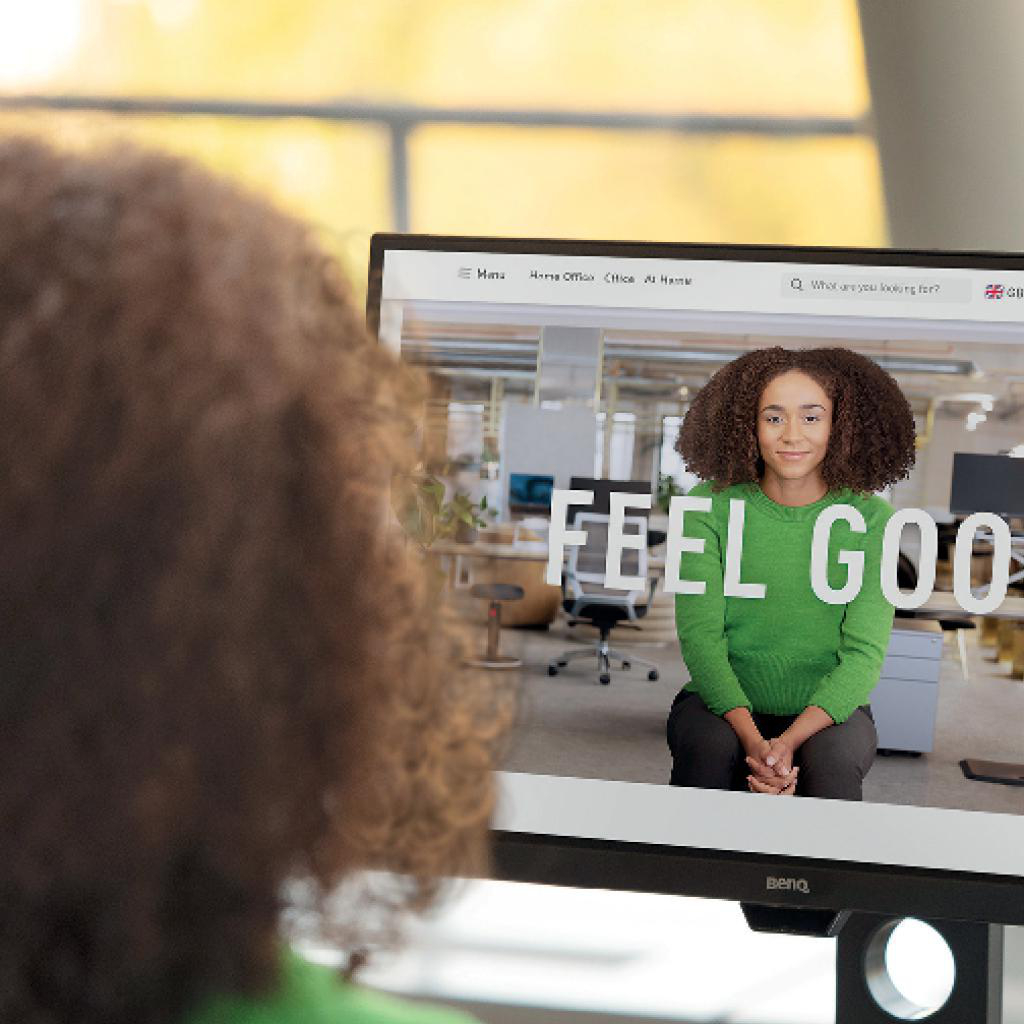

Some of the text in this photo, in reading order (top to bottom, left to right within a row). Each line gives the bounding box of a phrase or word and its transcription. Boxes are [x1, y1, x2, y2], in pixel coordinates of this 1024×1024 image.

[477, 268, 506, 280] Menu
[563, 271, 595, 282] Office
[811, 280, 836, 290] What
[857, 284, 877, 293] you
[918, 284, 941, 294] for?
[1006, 287, 1024, 298] GB
[545, 489, 767, 599] FEEL
